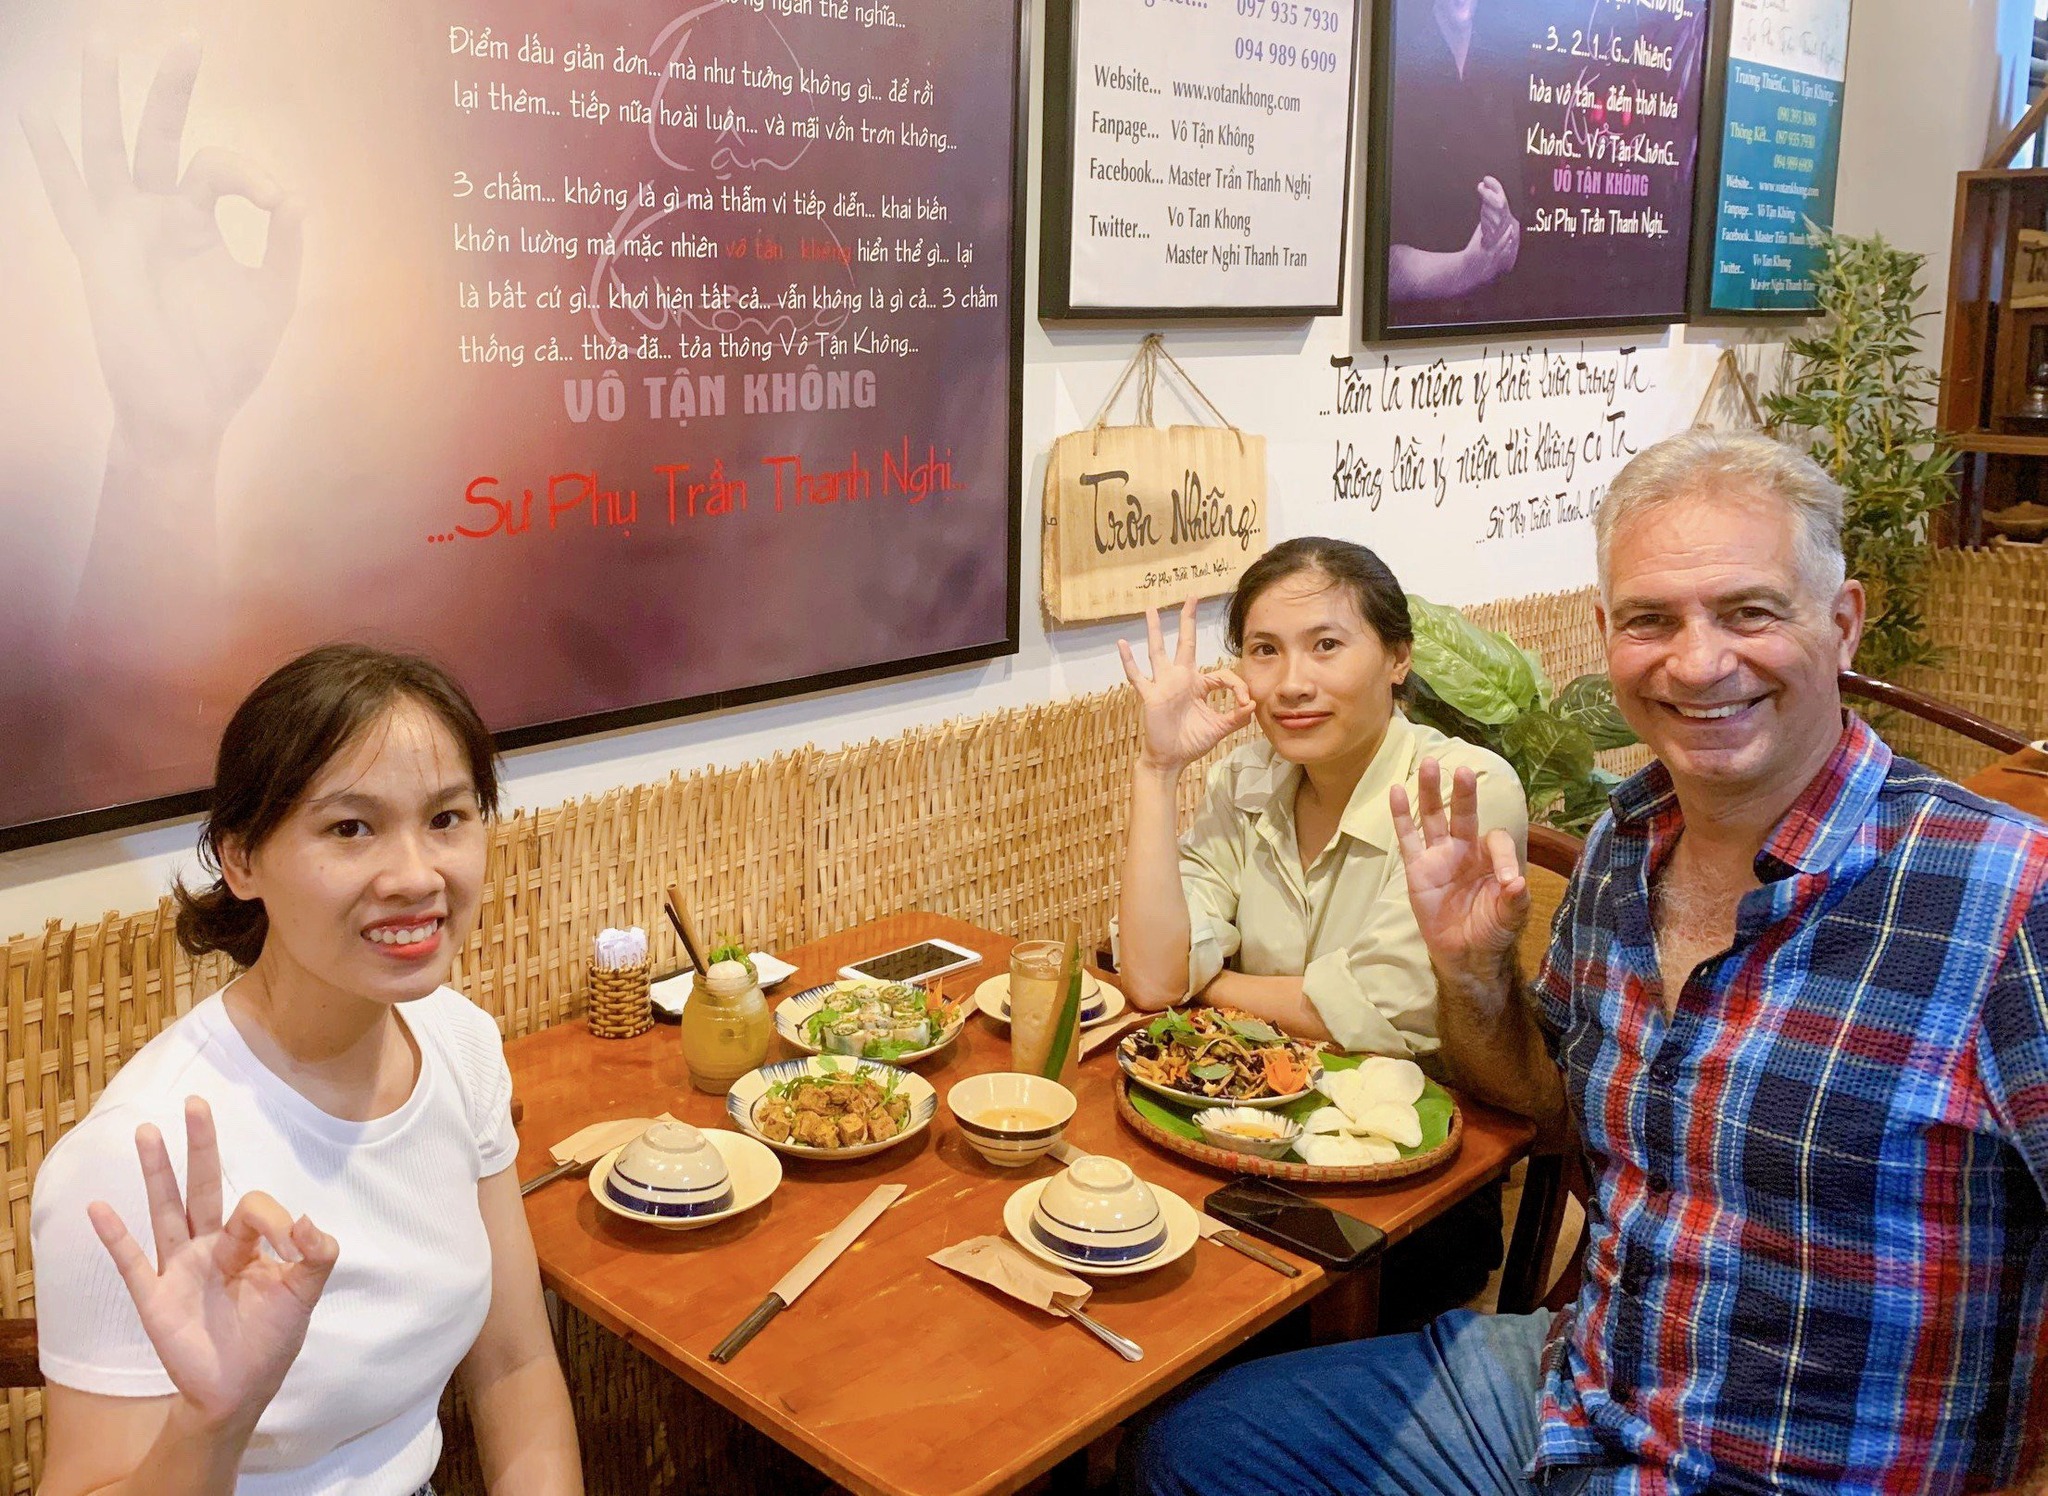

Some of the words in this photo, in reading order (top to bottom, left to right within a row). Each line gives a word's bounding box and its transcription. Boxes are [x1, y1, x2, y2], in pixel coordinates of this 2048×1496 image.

[856, 3, 905, 28] nghĩa...
[1236, 0, 1264, 19] 097
[1271, 0, 1298, 26] 935
[1303, 7, 1339, 33] 7930
[449, 25, 508, 59] Điểm
[518, 33, 553, 64] dấu
[563, 43, 604, 72] giản
[613, 46, 661, 77] đơn...
[669, 58, 696, 80] mà
[704, 57, 734, 84] như
[742, 61, 792, 95] tưởng
[800, 68, 850, 99] không
[858, 78, 882, 103] gì...
[888, 78, 909, 103] để
[914, 80, 933, 105] rồi
[1235, 36, 1264, 62] 094
[1269, 42, 1297, 67] 989
[1301, 48, 1337, 74] 6909
[1634, 35, 1672, 71] NhiênG
[1094, 64, 1161, 95] Website...
[1173, 80, 1301, 115] www.votankhong.com
[1530, 74, 1551, 103] hòa
[1556, 83, 1571, 105] vô
[1575, 80, 1602, 113] tận...
[1607, 85, 1632, 112] điểm
[1660, 92, 1678, 118] hóa
[454, 80, 479, 115] lại
[488, 82, 560, 116] thêm...
[570, 90, 610, 125] tiếp
[619, 100, 651, 124] nữa
[661, 99, 697, 128] hoài
[706, 105, 758, 134] luôn...
[765, 113, 785, 136] và
[792, 116, 819, 139] mãi
[825, 115, 854, 142] vốn
[861, 119, 895, 145] trơn
[901, 122, 957, 152] không...
[1092, 111, 1159, 144] Fanpage...
[1171, 119, 1188, 142] Vô
[1192, 121, 1214, 149] Tận
[1218, 123, 1255, 155] Không
[1527, 122, 1581, 158] KhônG...
[1587, 128, 1605, 159] Vô
[1609, 135, 1630, 167] Tận
[453, 171, 473, 197] 3
[484, 171, 556, 202] chấm...
[565, 176, 627, 211] không
[639, 181, 655, 207] là
[664, 185, 679, 213] gì
[688, 188, 713, 211] mà
[721, 186, 766, 214] thẫm
[773, 192, 787, 215] vi
[793, 190, 825, 220] tiếp
[833, 191, 875, 219] diễn...
[882, 195, 912, 220] khai
[918, 196, 947, 221] biến
[1090, 157, 1164, 185] Facebook...
[1168, 164, 1211, 188] Master
[1215, 165, 1242, 190] Trần
[1246, 169, 1281, 193] Thanh
[1284, 174, 1311, 200] Nghị
[1554, 165, 1572, 192] VÔ
[1577, 166, 1600, 198] TẬN
[1605, 169, 1649, 196] KHÔNG
[1090, 214, 1150, 239] Twitter...
[1167, 205, 1184, 228] Vo
[1188, 207, 1210, 229] Tan
[1215, 208, 1251, 237] Khong
[1527, 208, 1552, 232] ...Sư
[1555, 208, 1577, 237] Phụ
[1581, 208, 1605, 234] Trần
[1609, 210, 1638, 235] Thanh
[1755, 230, 1774, 243] Master
[454, 223, 509, 252] khôn
[521, 227, 578, 259] lường
[587, 232, 616, 255] mà
[624, 233, 663, 262] mặc
[672, 232, 718, 258] nhiên
[858, 236, 888, 263] hiển
[895, 238, 923, 263] thể
[927, 242, 950, 267] gì...
[957, 242, 973, 269] lại
[1165, 243, 1208, 265] Master
[1212, 244, 1240, 272] Nghi
[1244, 245, 1279, 267] Thanh
[1283, 247, 1307, 267] Tran
[459, 281, 479, 309] là
[488, 279, 527, 309] bất
[536, 285, 562, 308] cứ
[569, 285, 600, 314] gì...
[609, 282, 648, 309] khơi
[656, 284, 693, 314] hiện
[700, 282, 731, 309] tất
[738, 286, 770, 310] cả...
[777, 283, 806, 309] vẫn
[813, 286, 862, 313] không
[870, 286, 884, 309] là
[890, 289, 903, 312] gì
[909, 287, 936, 308] cả...
[942, 287, 956, 308] 3
[961, 284, 998, 308] chấm
[458, 332, 524, 367] thống
[534, 336, 573, 362] cả...
[581, 334, 628, 360] thỏa
[636, 334, 671, 360] đã...
[679, 334, 712, 359] tỏa
[719, 333, 772, 361] thông
[779, 328, 808, 355] Vô
[815, 332, 848, 360] Tận
[854, 326, 919, 358] Không...
[564, 369, 626, 423] VÔ
[643, 367, 726, 428] TẬN
[743, 364, 876, 415] KHÔNG
[1411, 358, 1463, 417] niệm
[1539, 348, 1571, 399] luôn
[1333, 440, 1383, 511] không
[1391, 436, 1426, 492] liền
[1457, 434, 1501, 489] niệm
[1506, 427, 1530, 476] thì
[1607, 411, 1637, 457] Ta
[427, 475, 533, 543] ...Sư
[548, 470, 638, 538] Phụ
[653, 458, 748, 527] Trần
[762, 451, 870, 513] Thanh
